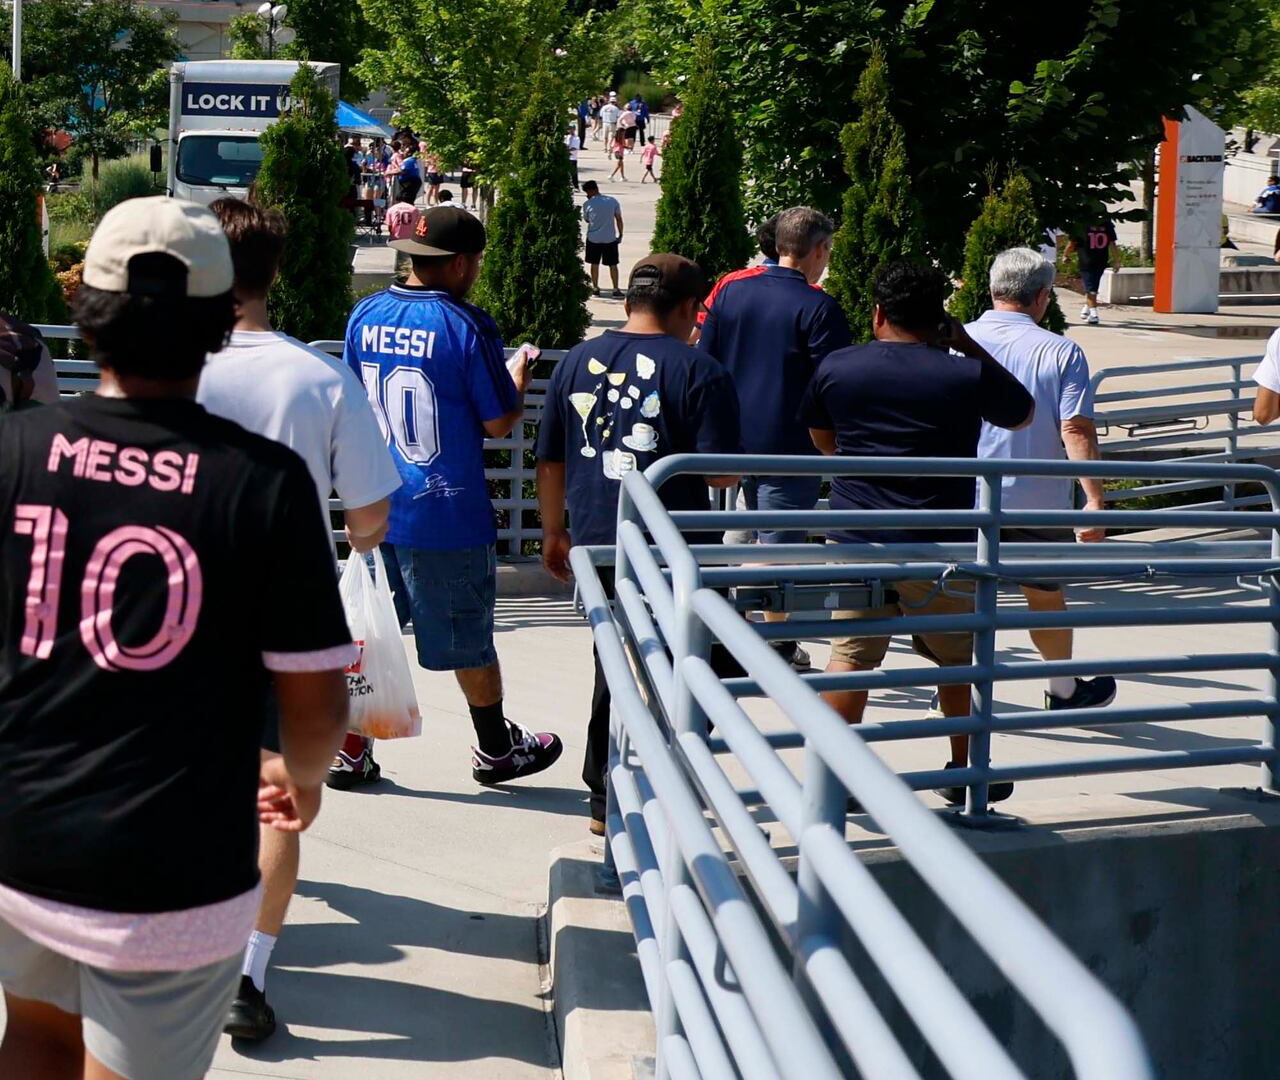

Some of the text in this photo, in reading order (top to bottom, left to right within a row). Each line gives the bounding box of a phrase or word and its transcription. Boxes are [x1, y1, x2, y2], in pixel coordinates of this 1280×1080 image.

[187, 94, 245, 110] LOCK
[250, 96, 271, 111] IT
[1087, 232, 1108, 249] 10
[361, 325, 436, 359] MESSI
[361, 361, 441, 466] 10
[47, 432, 200, 495] MESSI
[13, 504, 203, 672] 10
